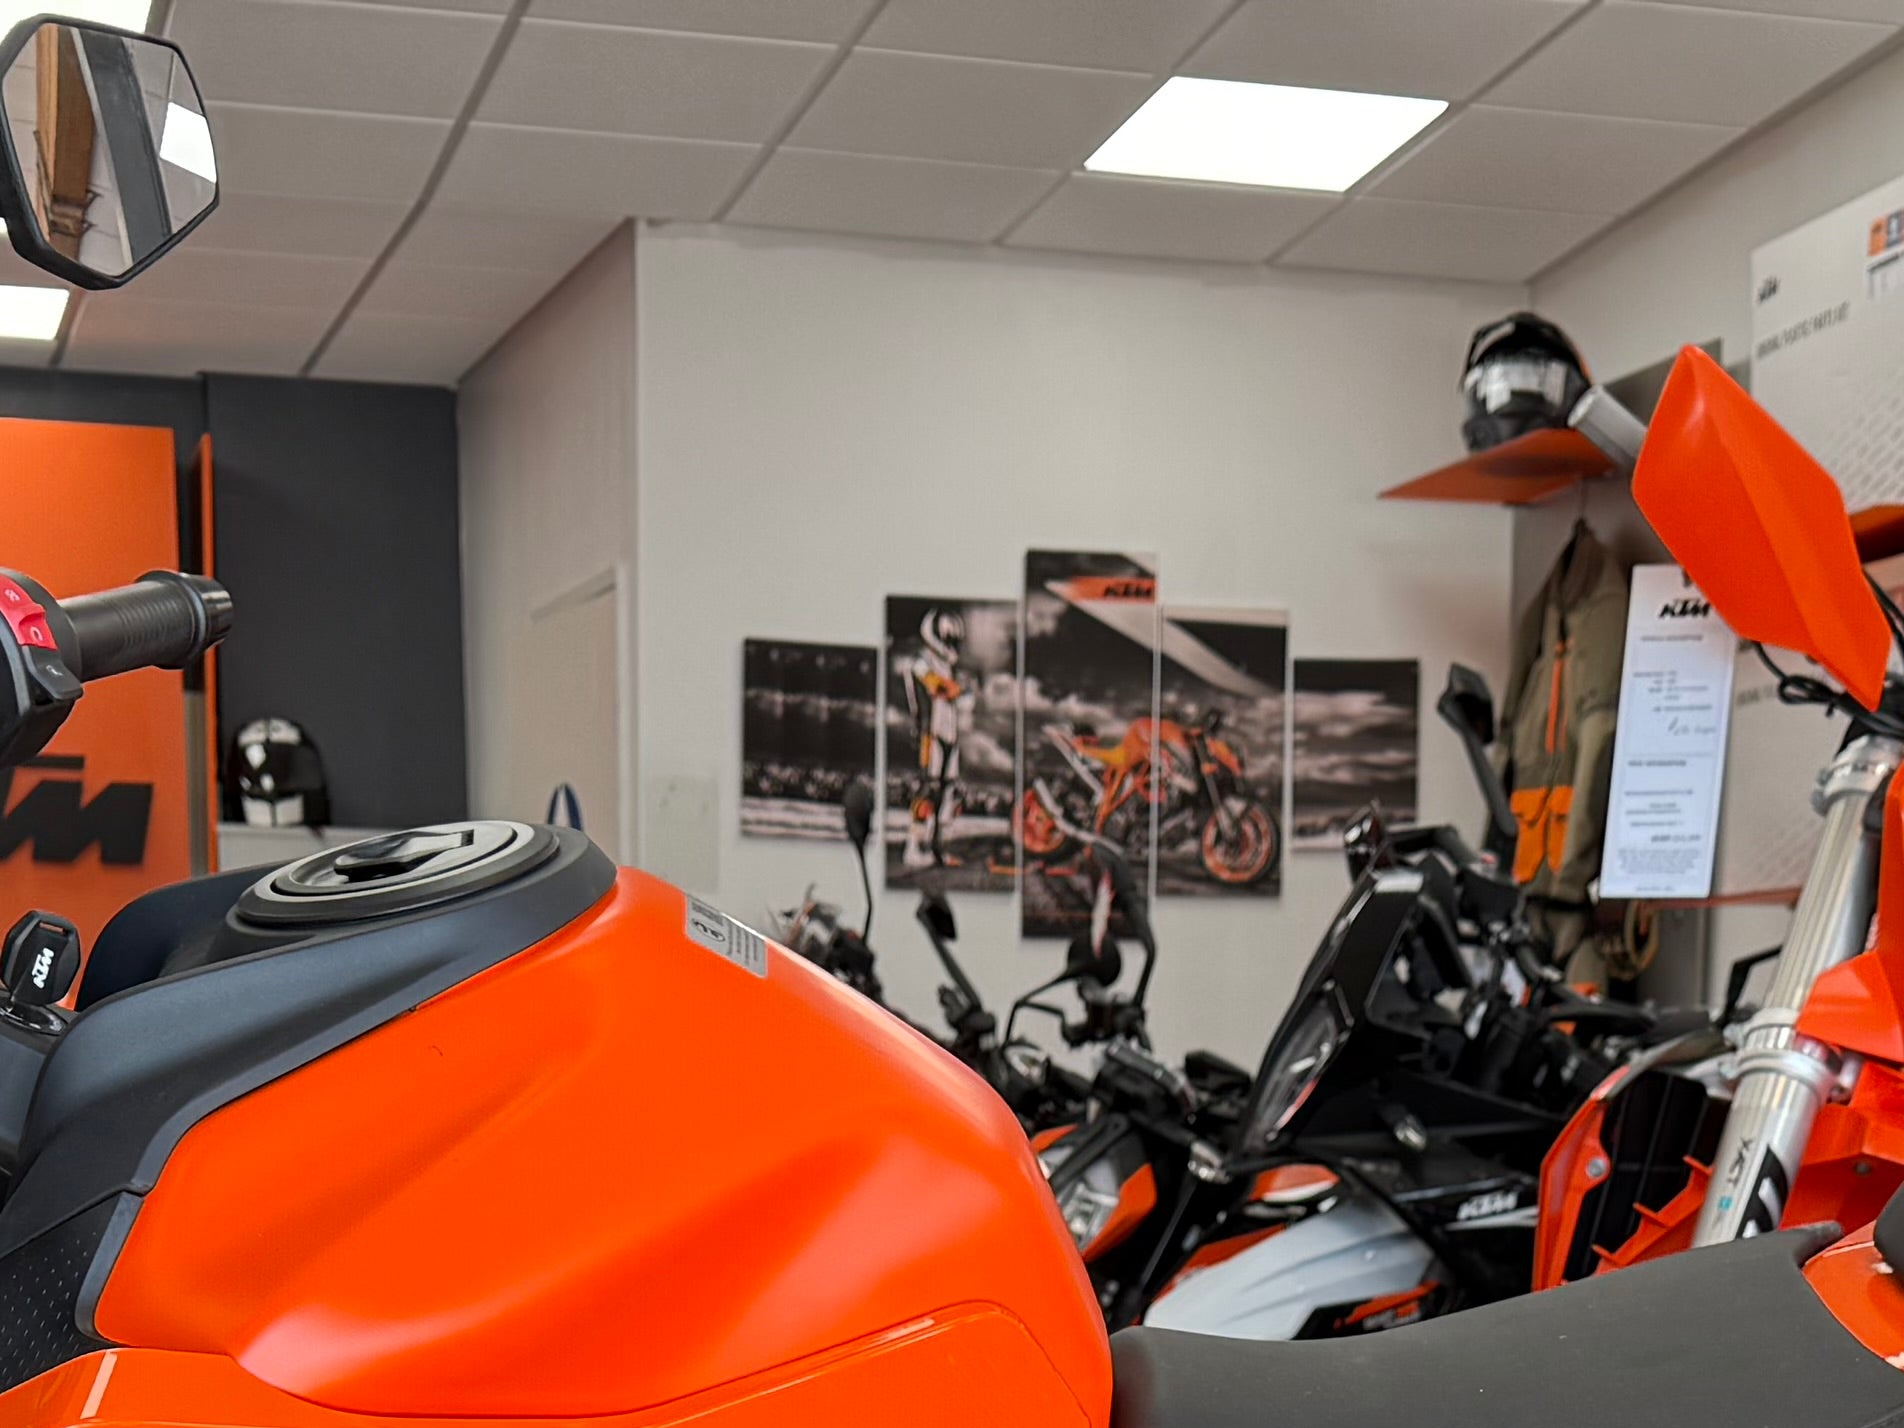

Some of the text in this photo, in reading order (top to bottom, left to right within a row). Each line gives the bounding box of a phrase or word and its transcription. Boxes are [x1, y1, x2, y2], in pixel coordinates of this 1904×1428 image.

[1659, 599, 1711, 618] KTM
[31, 947, 55, 989] KTM
[1456, 1191, 1519, 1222] KTM
